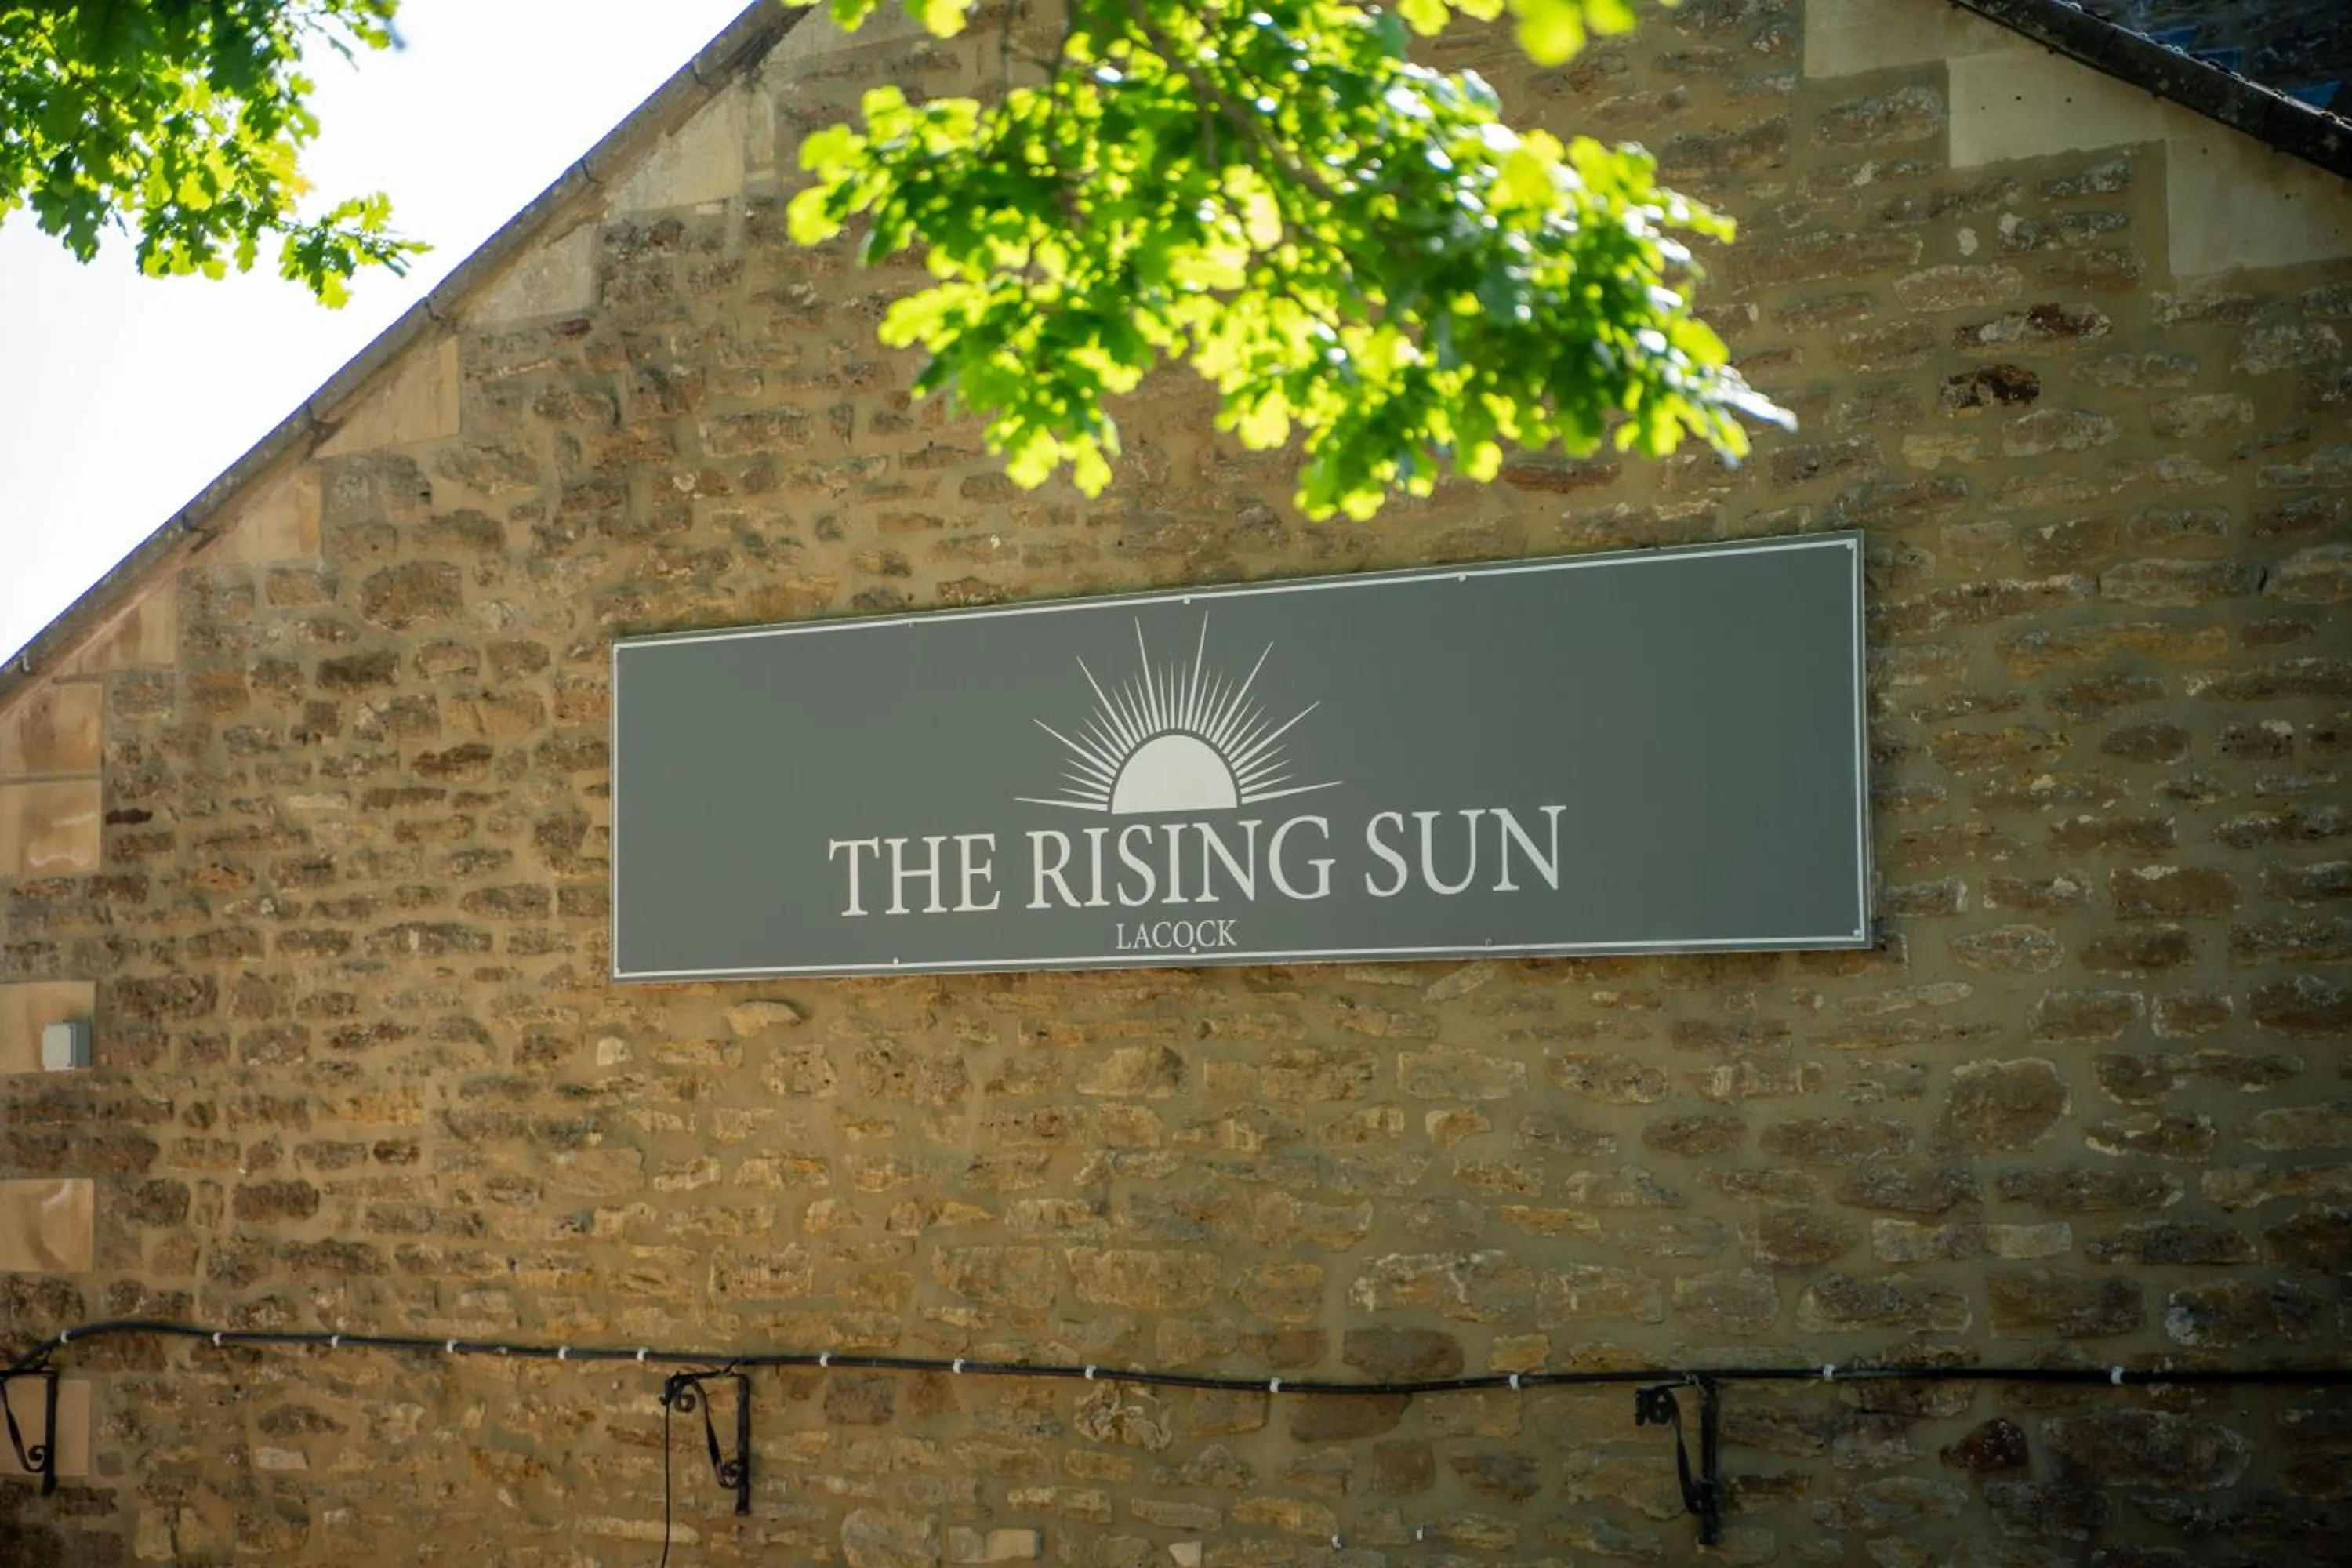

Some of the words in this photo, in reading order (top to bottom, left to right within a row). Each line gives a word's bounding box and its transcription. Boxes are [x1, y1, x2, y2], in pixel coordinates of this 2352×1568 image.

[829, 833, 1001, 916] THE
[1025, 815, 1336, 909] RISING
[1365, 804, 1567, 898] SUN
[1116, 919, 1237, 949] LACOCK
